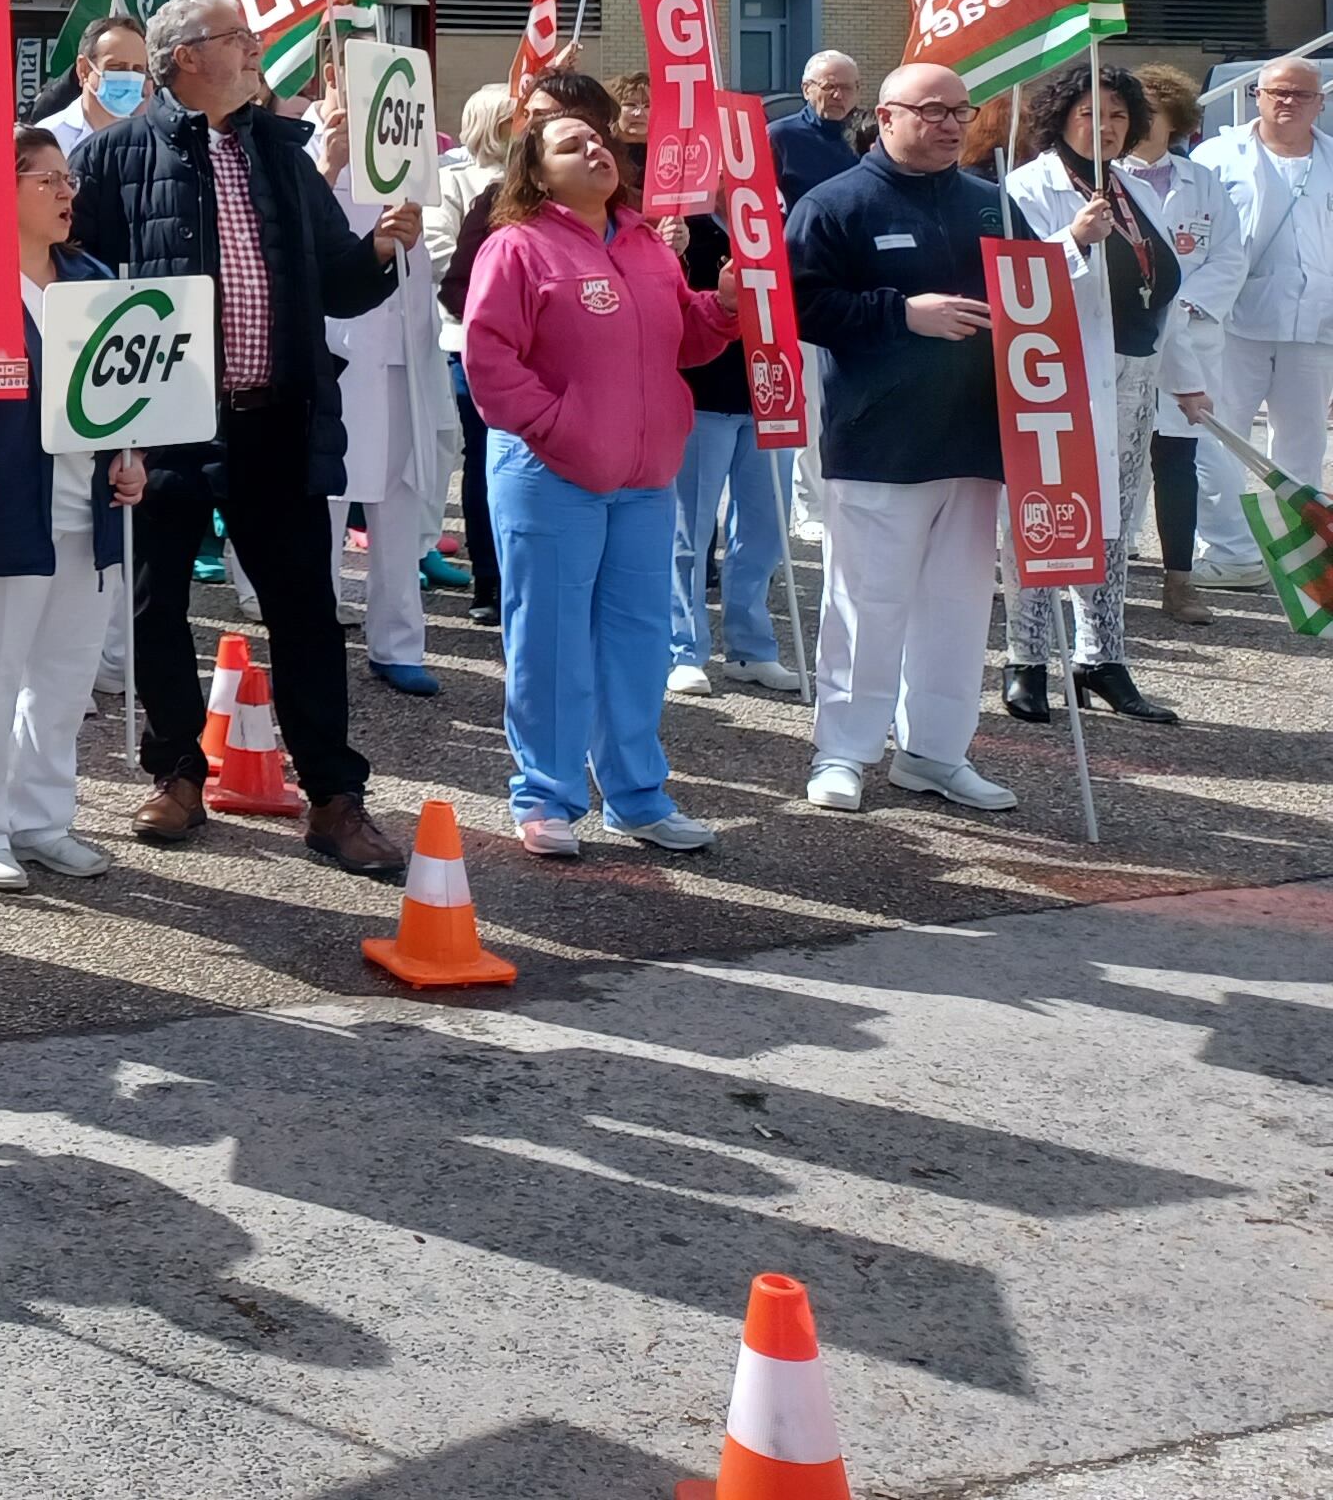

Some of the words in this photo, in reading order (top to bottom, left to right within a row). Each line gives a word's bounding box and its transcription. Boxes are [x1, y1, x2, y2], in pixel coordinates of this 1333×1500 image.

[718, 107, 778, 345] UGT
[997, 256, 1074, 485] UGT
[1024, 503, 1049, 525] UGT
[1055, 503, 1076, 521] FSP
